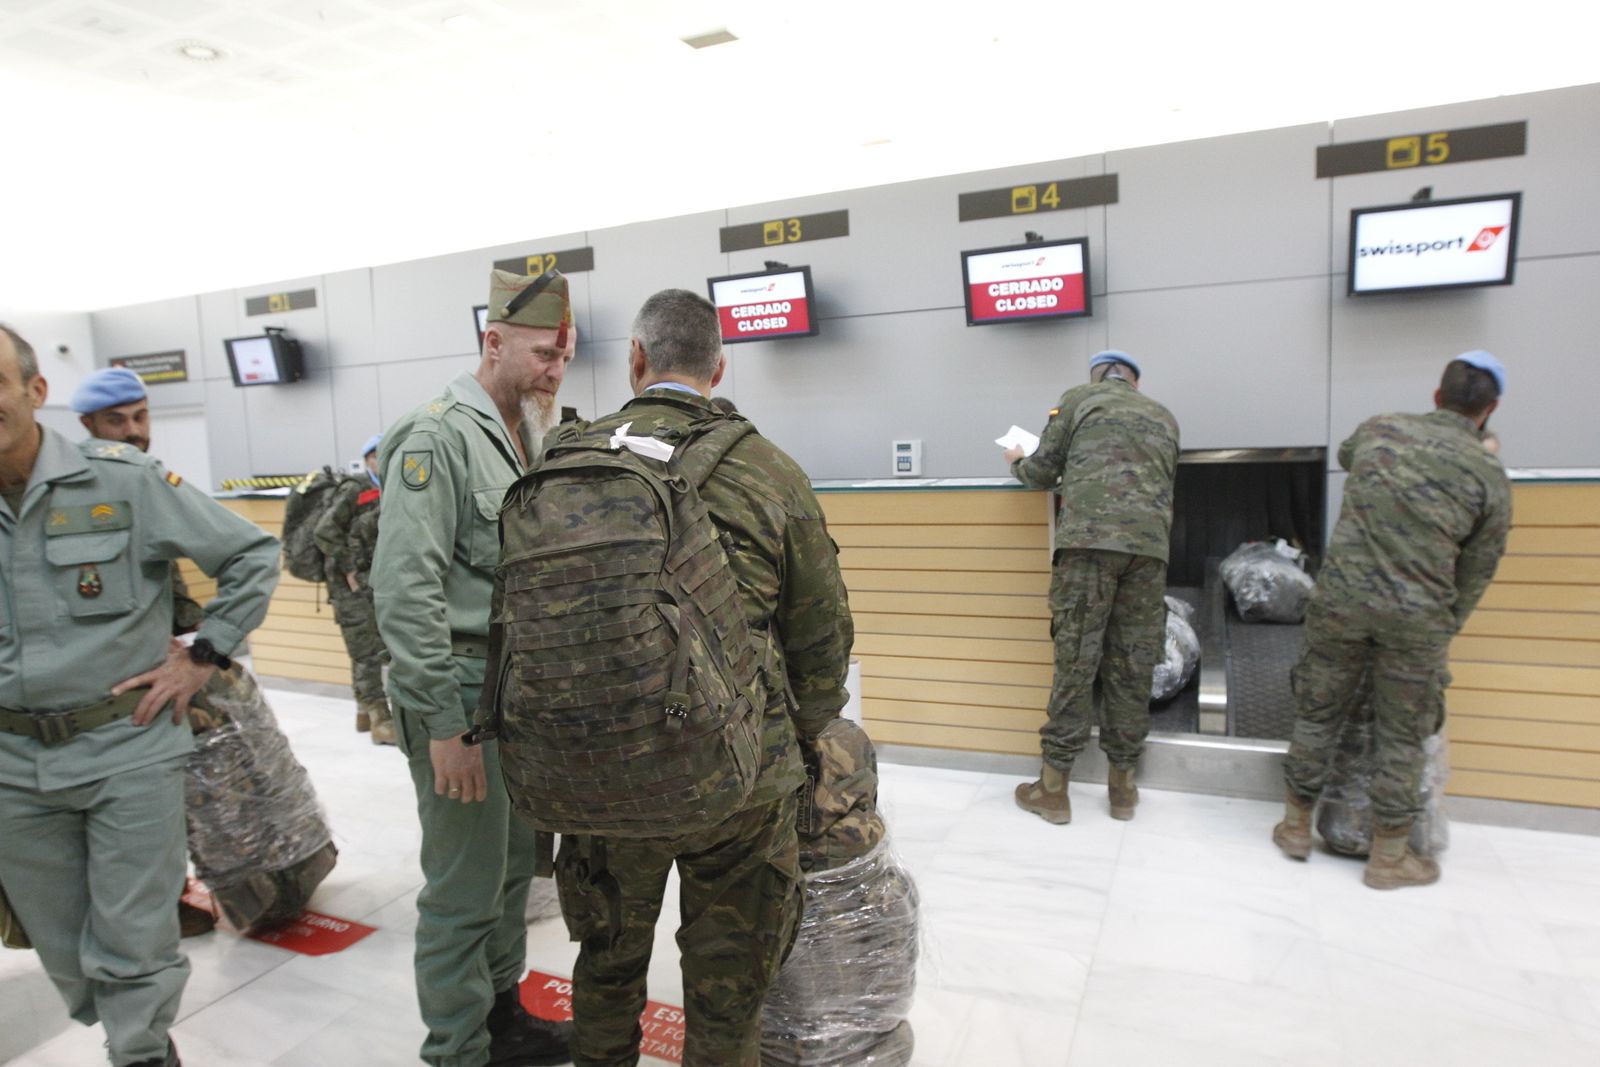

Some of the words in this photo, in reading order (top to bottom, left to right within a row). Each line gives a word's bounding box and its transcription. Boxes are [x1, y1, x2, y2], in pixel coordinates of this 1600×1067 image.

[1425, 132, 1450, 163] 5
[1040, 182, 1061, 209] 4
[787, 217, 802, 242] 3
[1359, 236, 1465, 258] swissport
[545, 253, 557, 271] 2
[988, 277, 1064, 296] CERRADO
[731, 301, 792, 318] CERRADO
[995, 294, 1058, 312] CLOSED
[737, 316, 788, 332] CLOSED
[301, 913, 350, 933] TURNO
[543, 978, 573, 996] PO
[662, 1027, 685, 1041] FO
